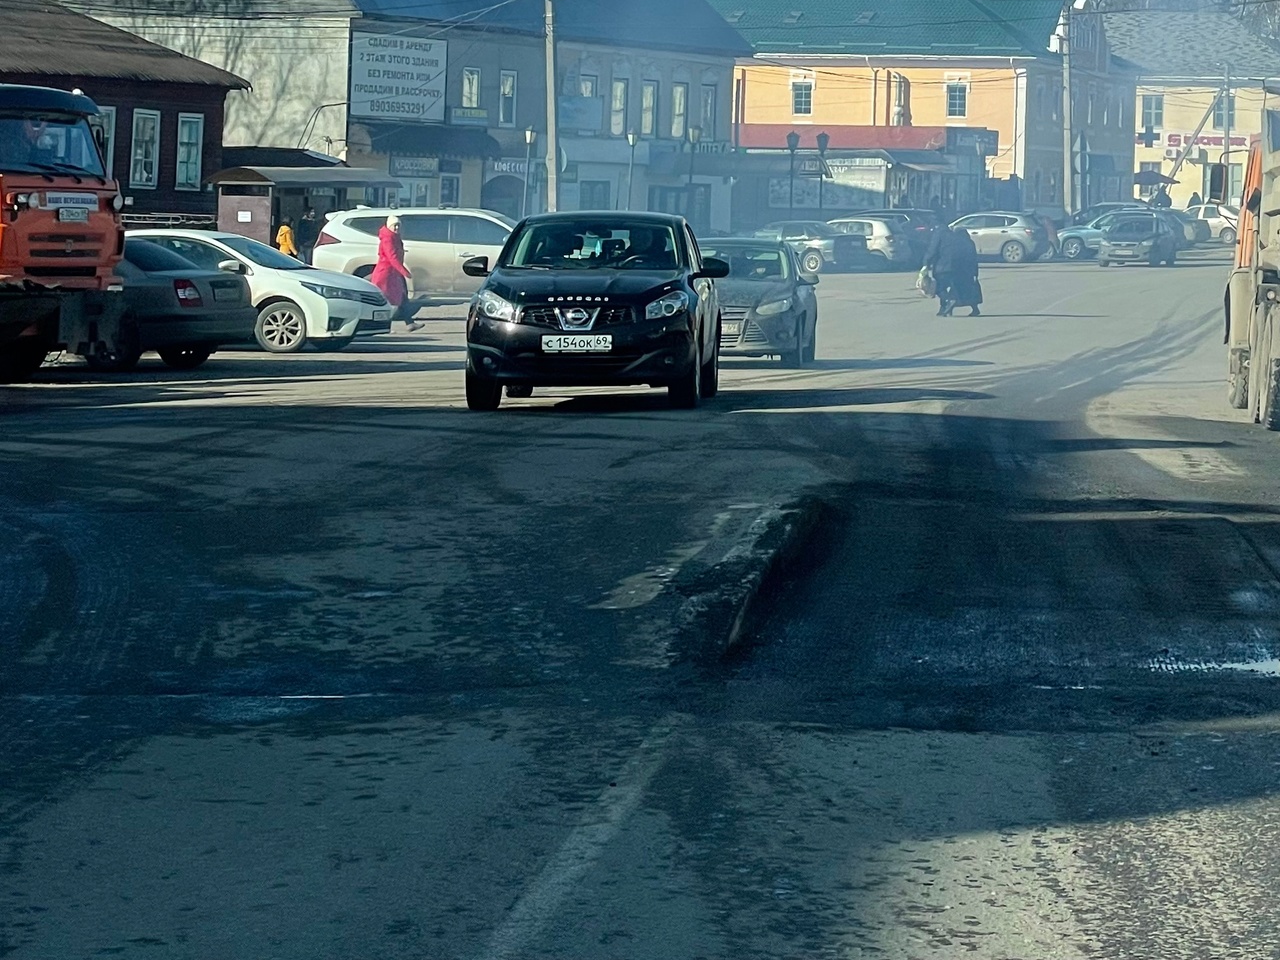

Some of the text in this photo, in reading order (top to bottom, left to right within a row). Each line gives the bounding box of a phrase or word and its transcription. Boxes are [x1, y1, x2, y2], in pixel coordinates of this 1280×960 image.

[368, 38, 398, 49] СДАДИМ
[405, 41, 433, 52] АРЕНДУ
[359, 52, 439, 68] 2 ЭТАЖ ЭТОГО ЗДАНИЯ
[367, 69, 431, 82] БЕЗ РЕМОНТА ИЛИ
[354, 83, 394, 95] ПРОДАДИМ
[369, 100, 426, 115] 89036953291
[596, 336, 608, 345] 69
